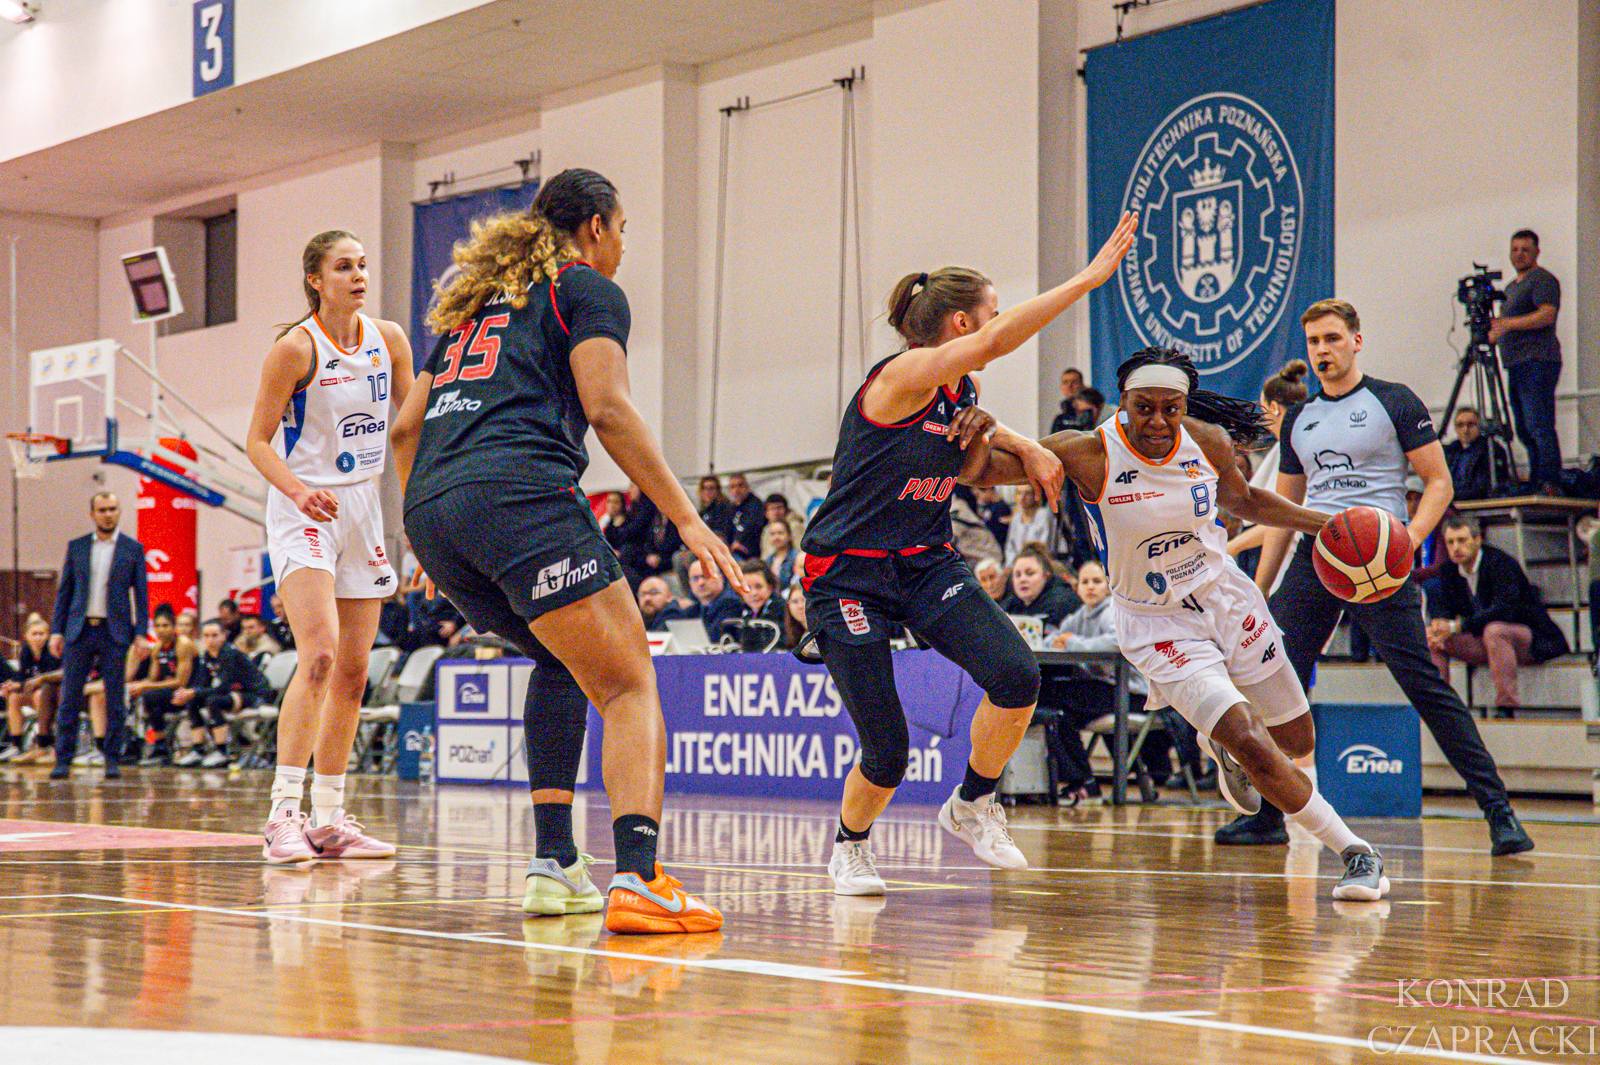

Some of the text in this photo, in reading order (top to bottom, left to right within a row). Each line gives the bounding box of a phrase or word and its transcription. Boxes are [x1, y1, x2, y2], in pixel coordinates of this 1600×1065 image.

[200, 3, 224, 83] 3
[1130, 104, 1288, 212] POLITECHNIKA POZNAŃSKA
[1226, 327, 1244, 354] OF
[1245, 204, 1296, 335] TECHNOLOGY
[432, 312, 511, 390] 35
[367, 372, 387, 403] 10
[342, 420, 386, 438] Enea
[1114, 469, 1139, 484] 4F
[1333, 479, 1367, 489] Pekao
[1190, 482, 1210, 518] 8
[374, 576, 391, 587] 4F
[942, 583, 964, 600] 4F
[1240, 620, 1269, 649] SELGROS
[1261, 642, 1276, 664] 4F
[704, 673, 843, 718] ENEA AZS
[665, 731, 828, 779] ITECHNIKA
[1346, 755, 1403, 774] Enea
